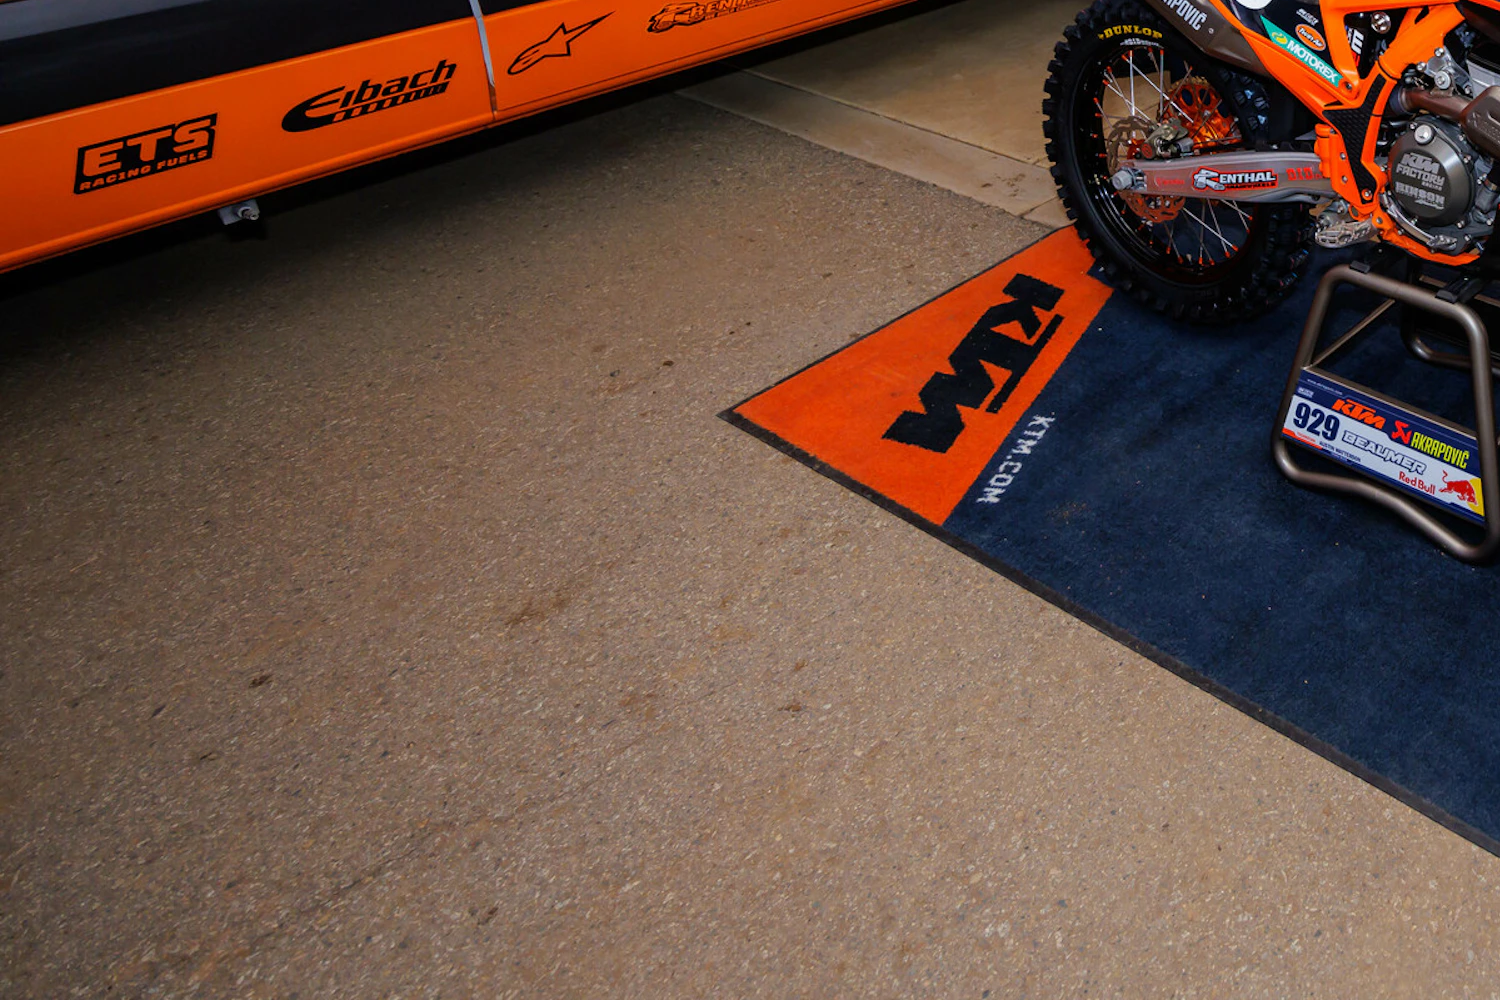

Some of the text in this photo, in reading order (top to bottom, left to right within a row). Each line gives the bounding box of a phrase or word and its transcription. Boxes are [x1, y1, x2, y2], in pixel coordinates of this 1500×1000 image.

[1103, 24, 1163, 39] DUNLOP
[1286, 39, 1339, 83] MOTOREX
[281, 59, 457, 133] Eibach
[82, 119, 213, 178] ETS
[1401, 152, 1440, 175] KTM
[79, 149, 208, 192] RACING FUELS
[1396, 163, 1446, 187] FACTORY
[881, 272, 1066, 455] KTM
[1293, 402, 1341, 442] 929
[1331, 398, 1387, 431] KTM
[975, 411, 1057, 505] KTM.COM
[1342, 429, 1428, 476] BEAUMER
[1410, 431, 1471, 470] AKRAPOVIČ
[1398, 470, 1437, 496] Red Bull
